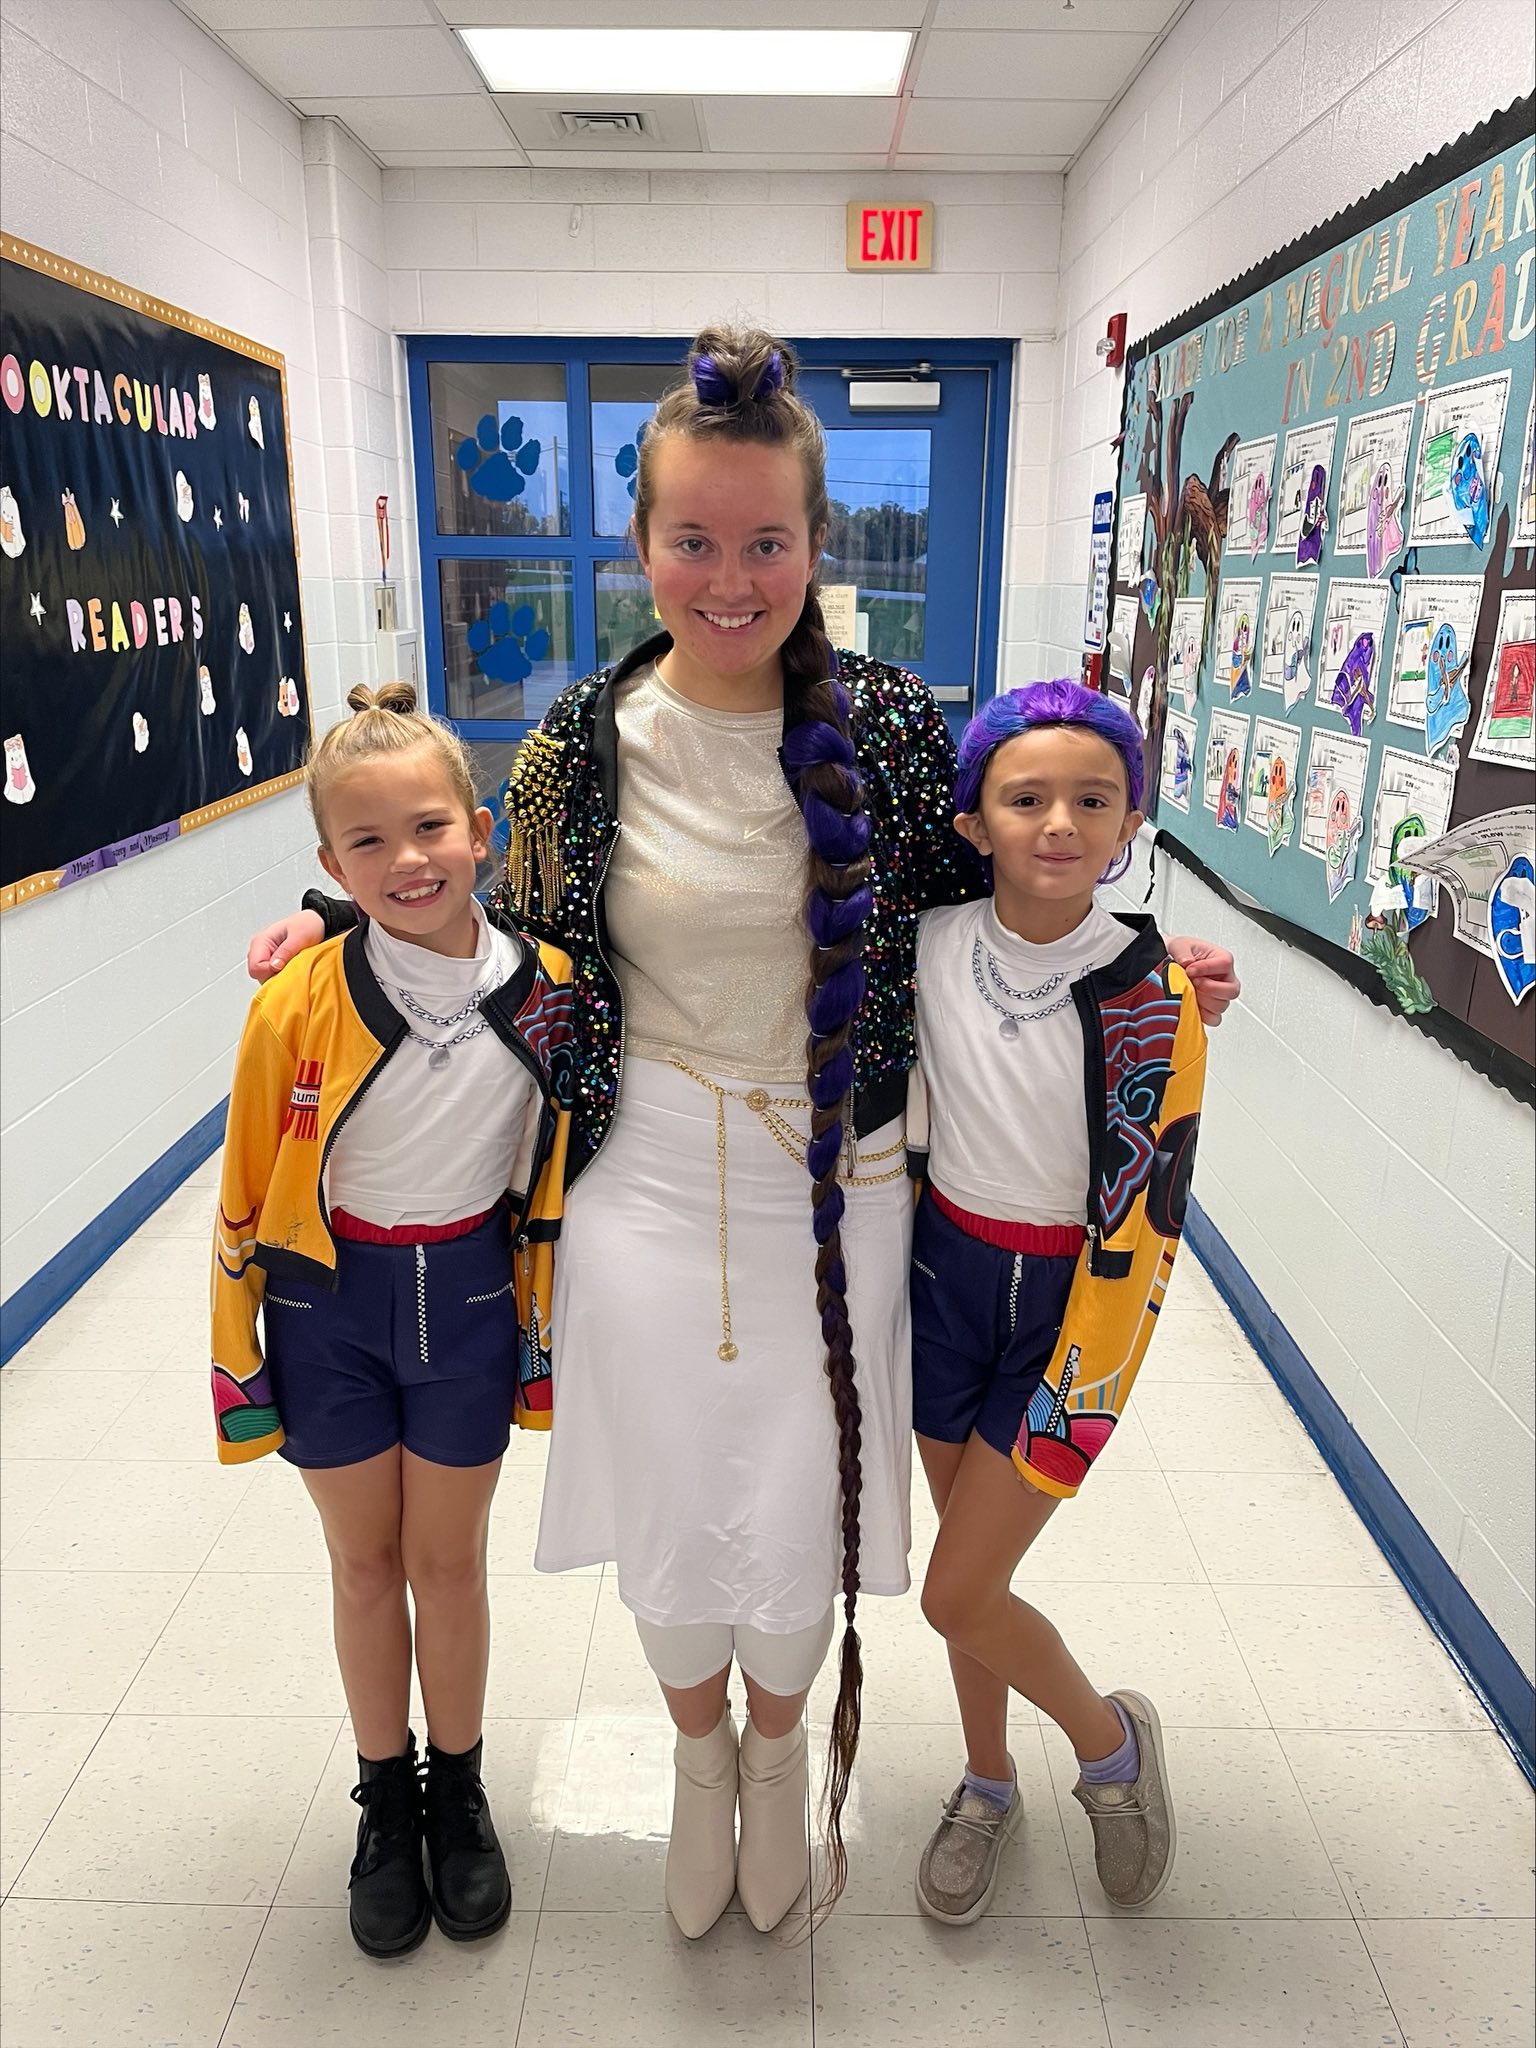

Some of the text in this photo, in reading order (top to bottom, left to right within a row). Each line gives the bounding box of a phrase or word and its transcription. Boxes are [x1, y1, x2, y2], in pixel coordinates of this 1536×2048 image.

[861, 208, 923, 262] EXIT
[1210, 307, 1250, 376] FOR
[1256, 291, 1274, 355] A
[1281, 213, 1414, 348] MAGICAL
[1433, 146, 1535, 277] YEAR
[1, 353, 198, 440] OOKTACULAR
[1281, 353, 1317, 425] IN
[1323, 320, 1397, 410] 2ND
[66, 595, 205, 653] READERS
